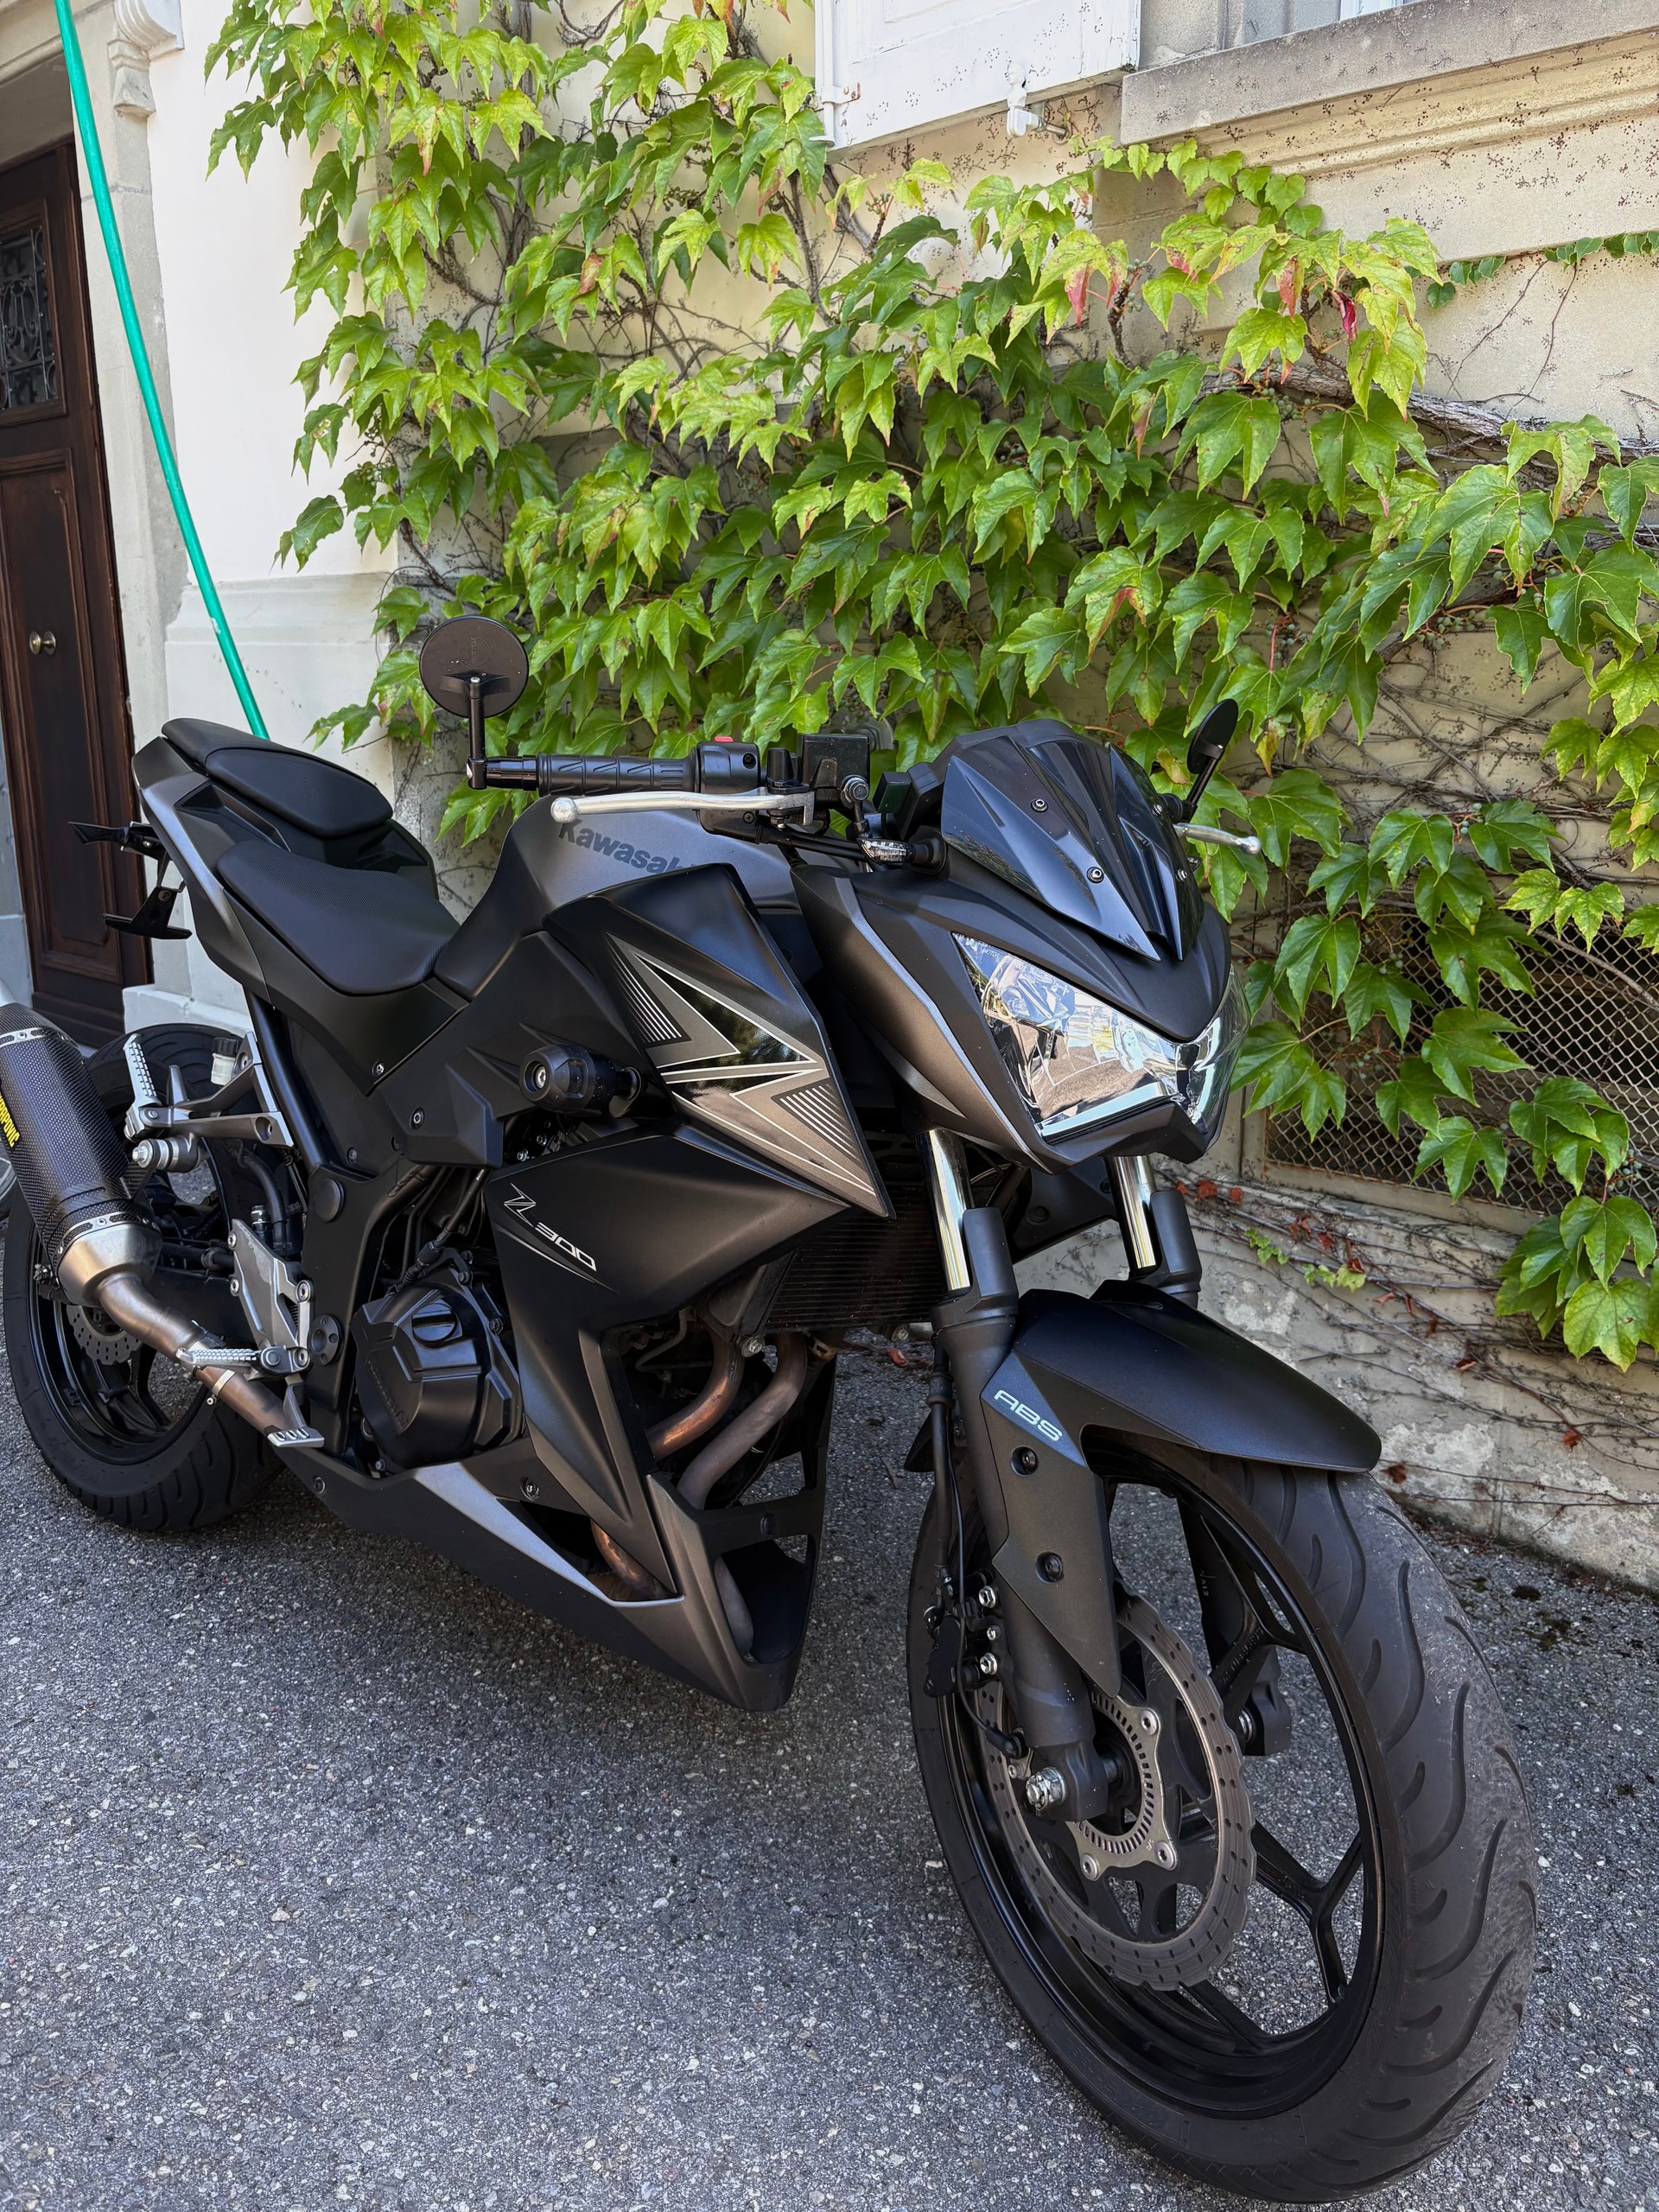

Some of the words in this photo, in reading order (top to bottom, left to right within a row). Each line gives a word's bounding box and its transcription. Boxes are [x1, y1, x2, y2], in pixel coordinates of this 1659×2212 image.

[558, 818, 695, 874] Kawasak
[0, 1092, 20, 1148] RAPOVIC
[994, 1389, 1063, 1441] ABS
